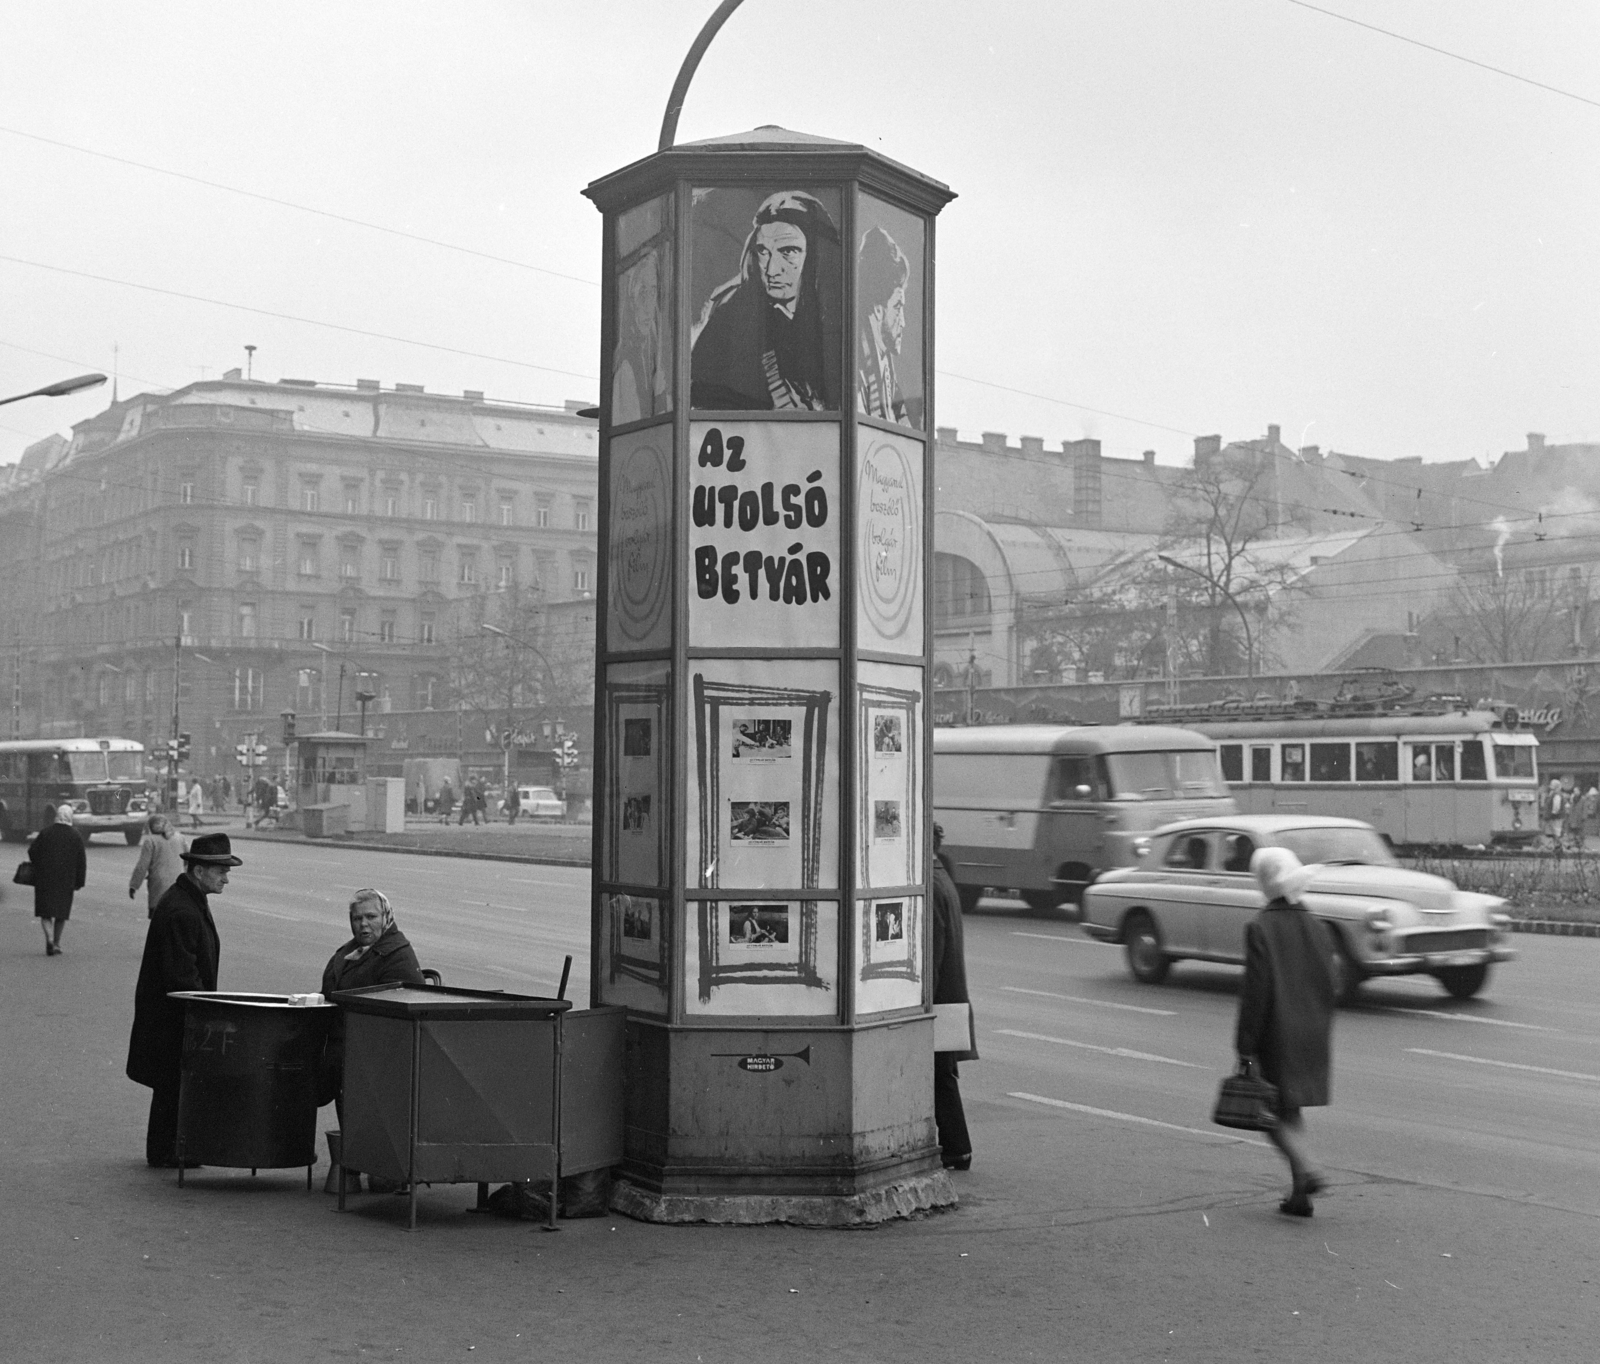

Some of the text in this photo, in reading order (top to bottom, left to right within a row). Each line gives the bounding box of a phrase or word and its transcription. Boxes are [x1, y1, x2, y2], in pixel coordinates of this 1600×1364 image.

[864, 459, 904, 493] Magyarul
[692, 469, 829, 533] UTOLSÓ
[871, 523, 899, 553] bolgár
[694, 543, 832, 606] BETYÁR
[875, 552, 897, 582] film
